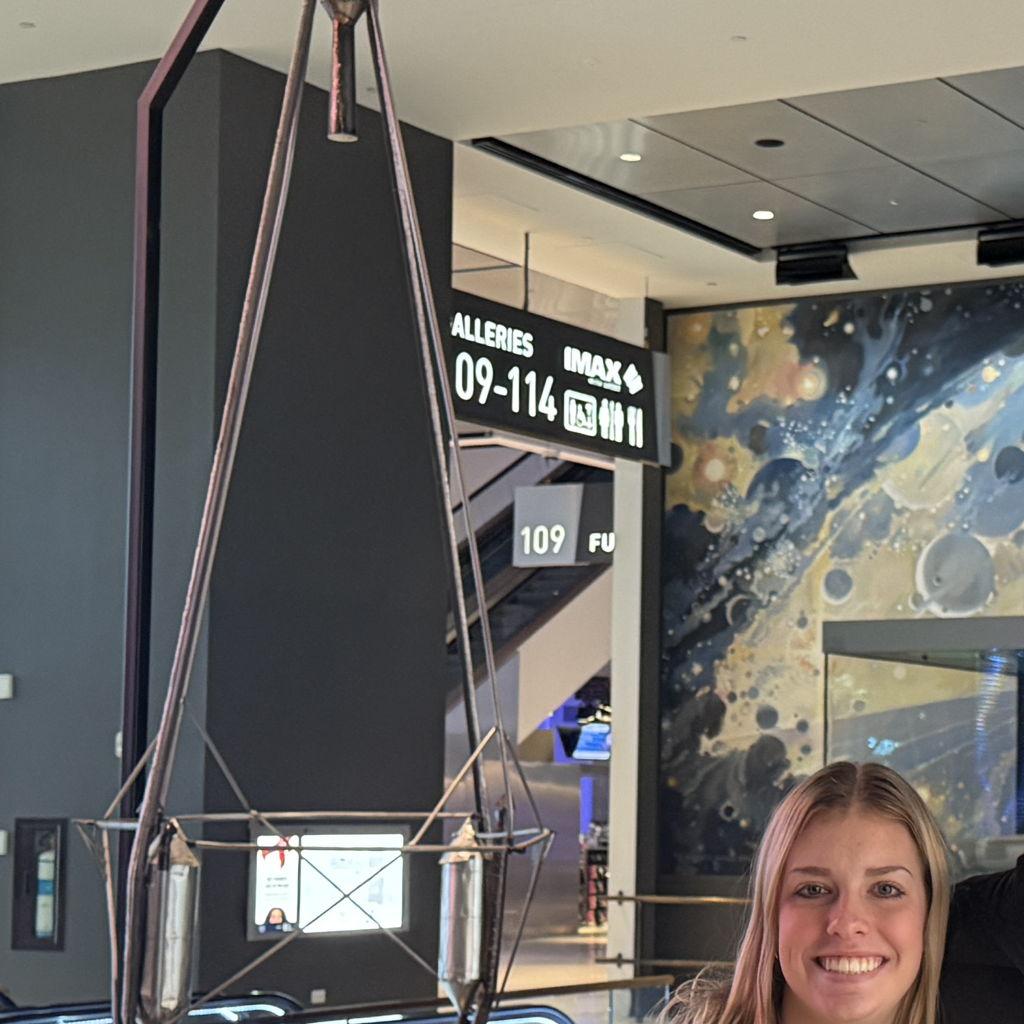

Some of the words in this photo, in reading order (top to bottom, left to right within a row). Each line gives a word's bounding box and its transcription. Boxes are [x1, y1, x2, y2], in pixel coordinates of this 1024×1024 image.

[450, 312, 534, 358] ALLERIES
[563, 346, 622, 386] IMAX
[521, 524, 566, 555] 109
[588, 532, 616, 553] FU
